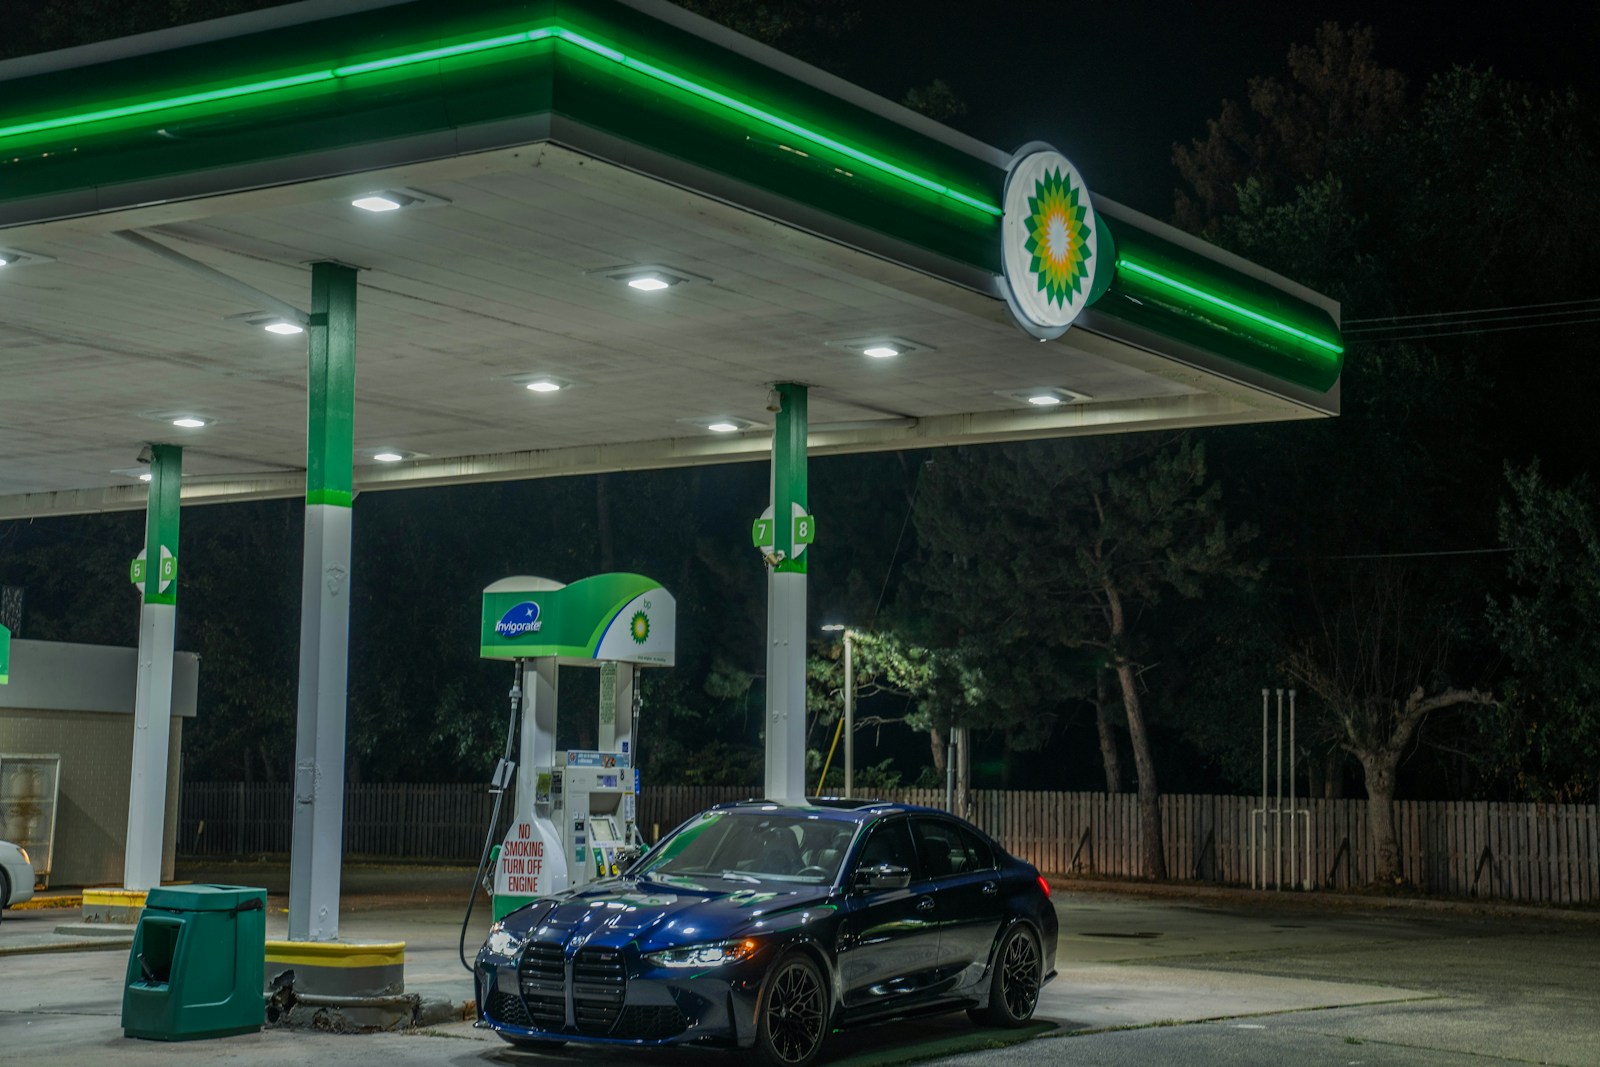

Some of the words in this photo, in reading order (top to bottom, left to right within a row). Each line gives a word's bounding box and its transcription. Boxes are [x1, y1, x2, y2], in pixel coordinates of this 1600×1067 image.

[758, 524, 766, 540] 7
[799, 521, 808, 537] 8
[134, 563, 141, 577] 5
[165, 561, 172, 575] 6
[643, 598, 652, 610] bp
[518, 823, 531, 840] NO
[504, 840, 544, 858] SMOKING
[502, 858, 525, 875] TURN
[527, 858, 543, 875] OFF
[508, 876, 538, 893] ENGINE
